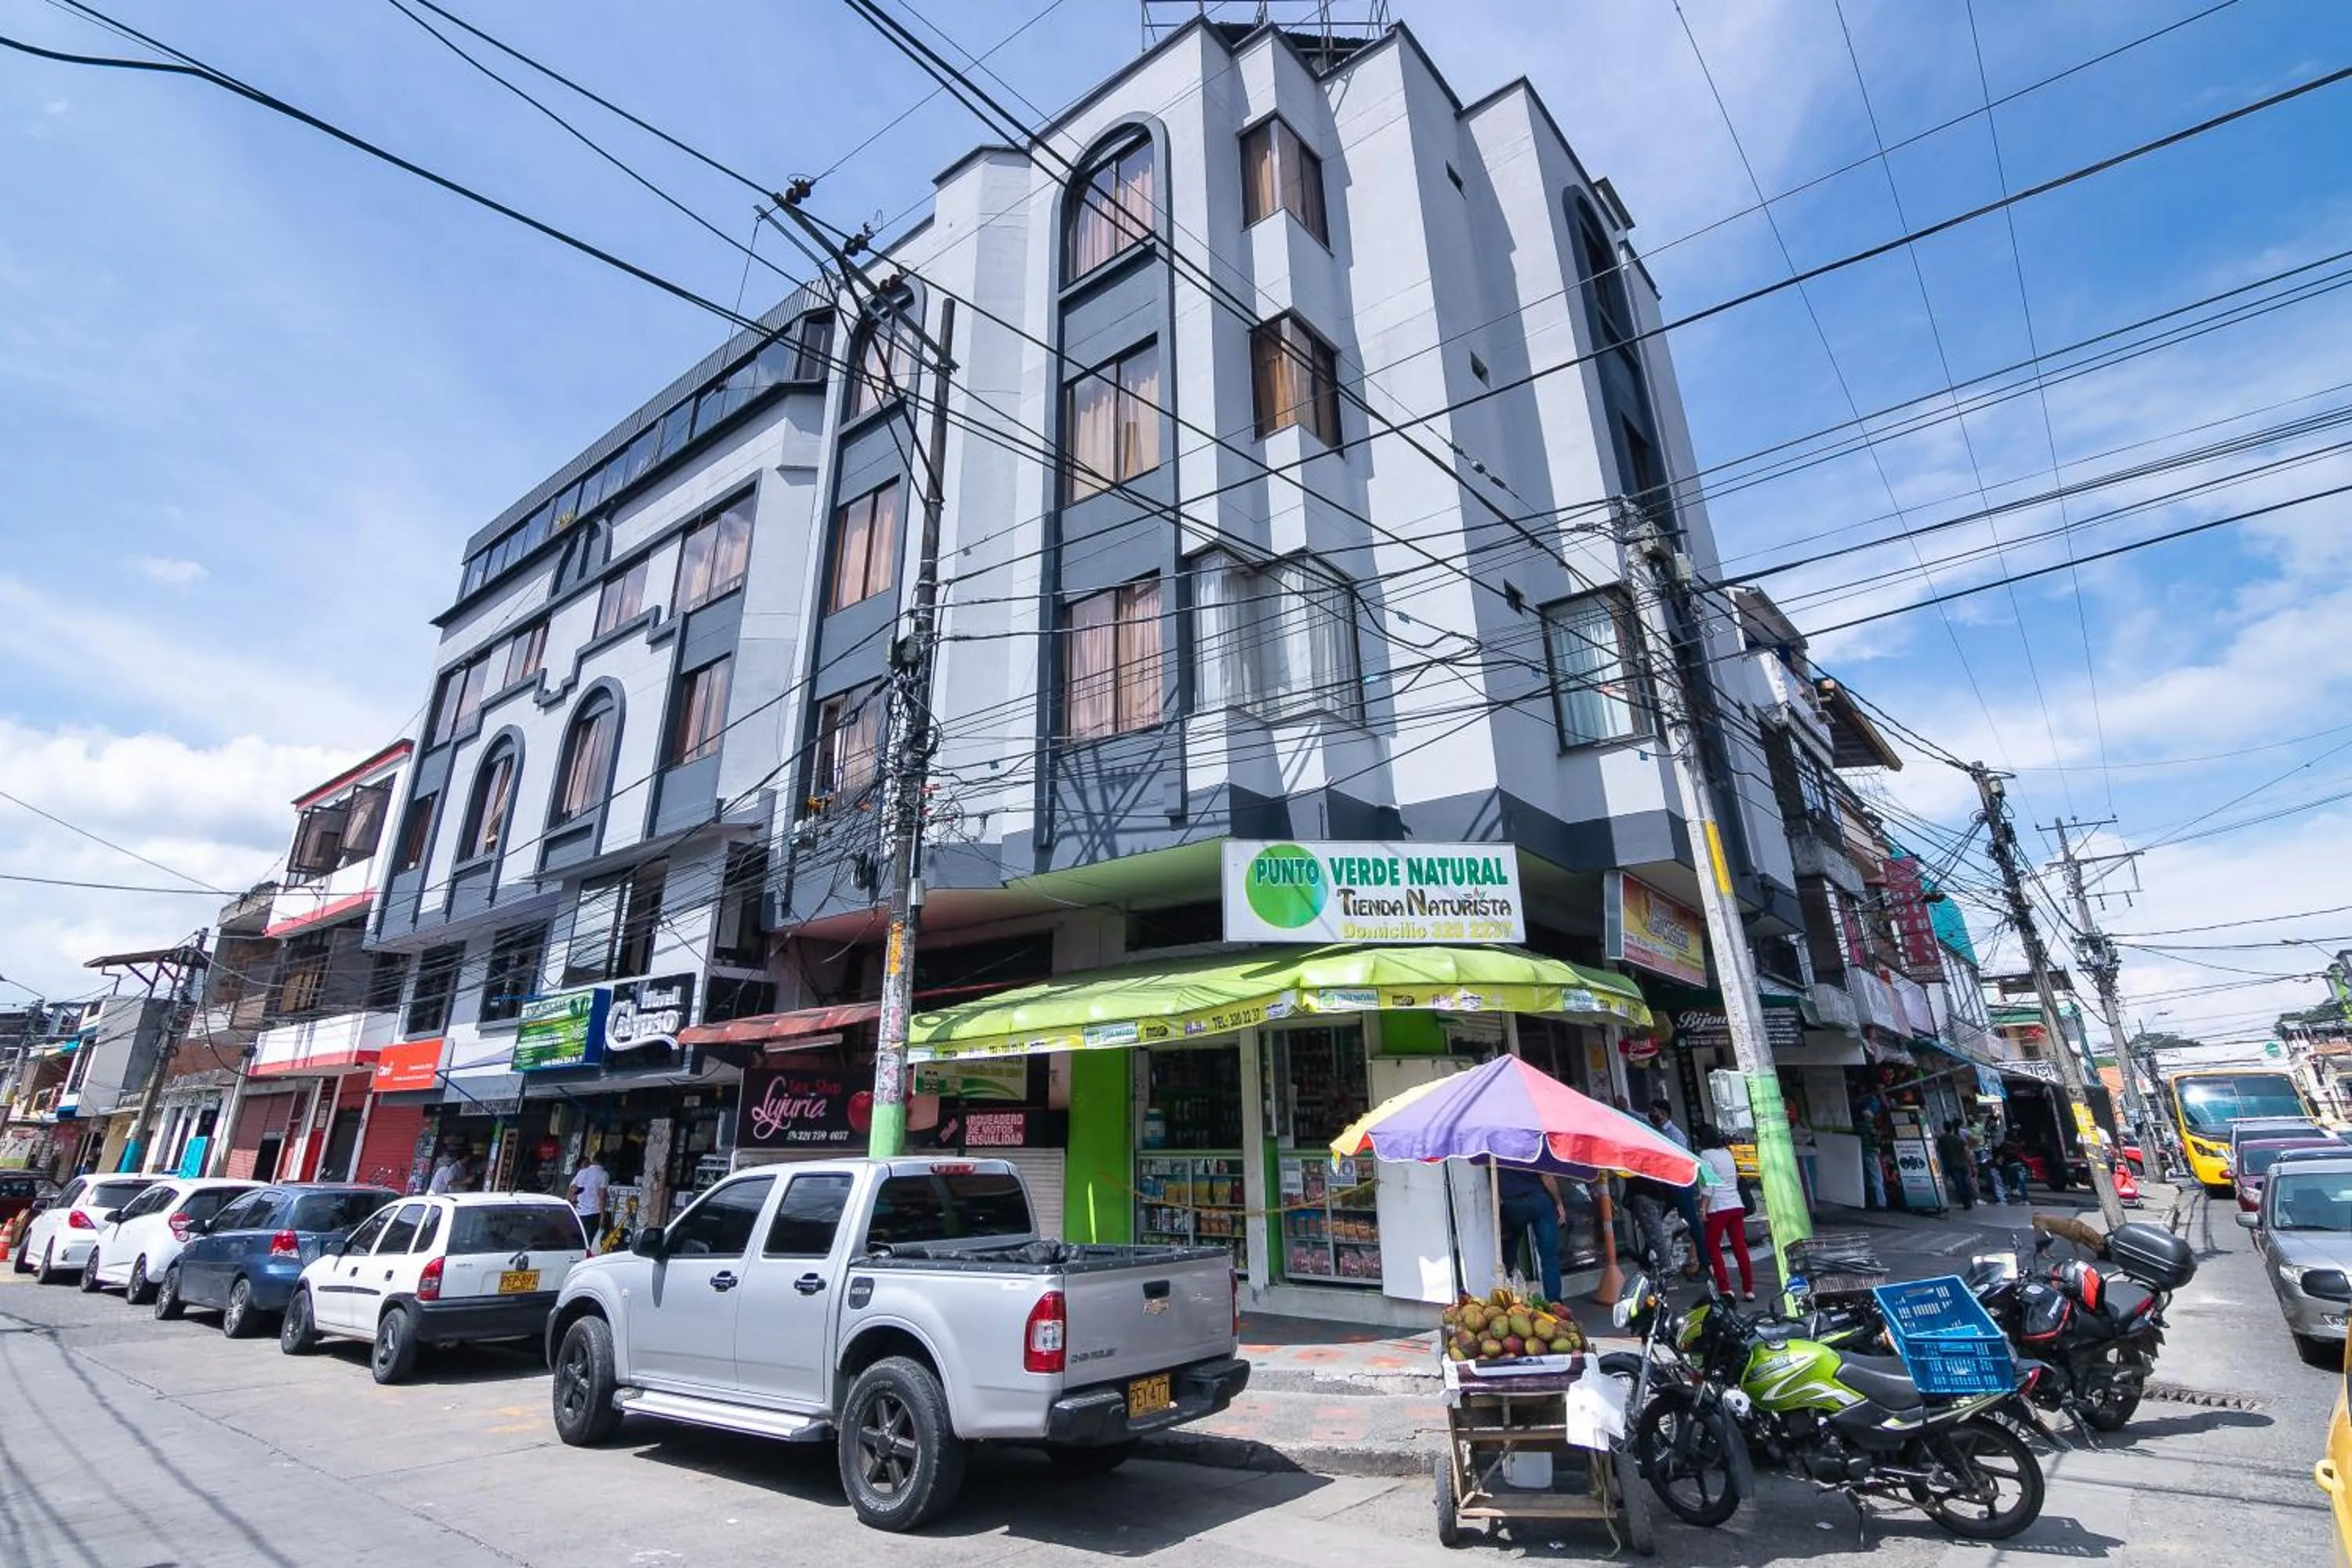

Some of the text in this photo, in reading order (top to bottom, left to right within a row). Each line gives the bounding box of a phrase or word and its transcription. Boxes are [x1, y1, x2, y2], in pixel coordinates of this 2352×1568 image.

[1256, 856, 1508, 887] PUNTO VERDE NATURAL
[1337, 888, 1512, 916] TIENDA NATURISTA
[1341, 920, 1427, 939] Domicilio
[752, 1076, 827, 1139] Lujuria
[965, 1114, 1024, 1125] ARQUEADERO
[968, 1125, 1014, 1134] DE MOTOS
[965, 1134, 1023, 1145] ENSUALIDAD
